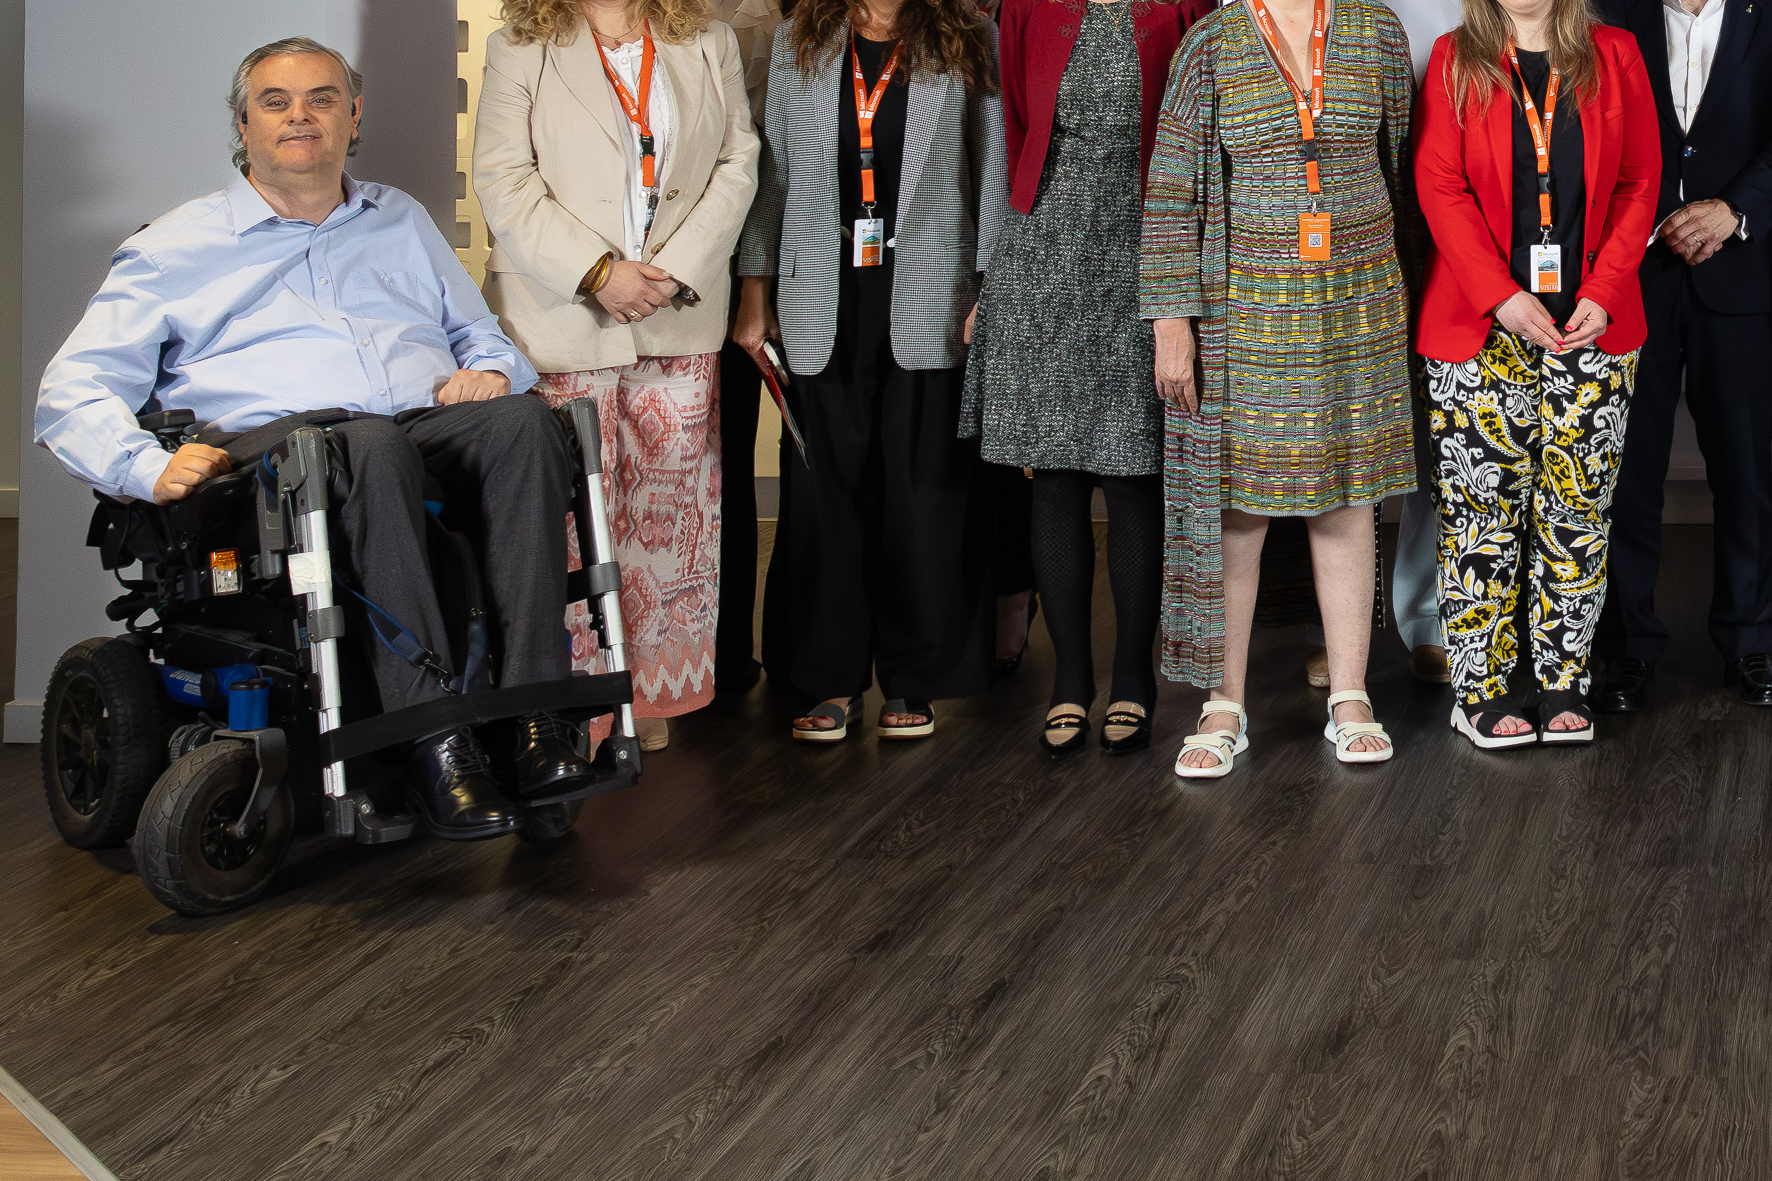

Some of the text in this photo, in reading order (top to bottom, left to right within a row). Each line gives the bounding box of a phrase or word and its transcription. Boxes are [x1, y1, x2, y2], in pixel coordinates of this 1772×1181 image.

[1262, 16, 1273, 36] Microsoft
[858, 88, 866, 110] Microsoft
[868, 89, 882, 111] Microsoft
[1532, 123, 1543, 147] Microsoft
